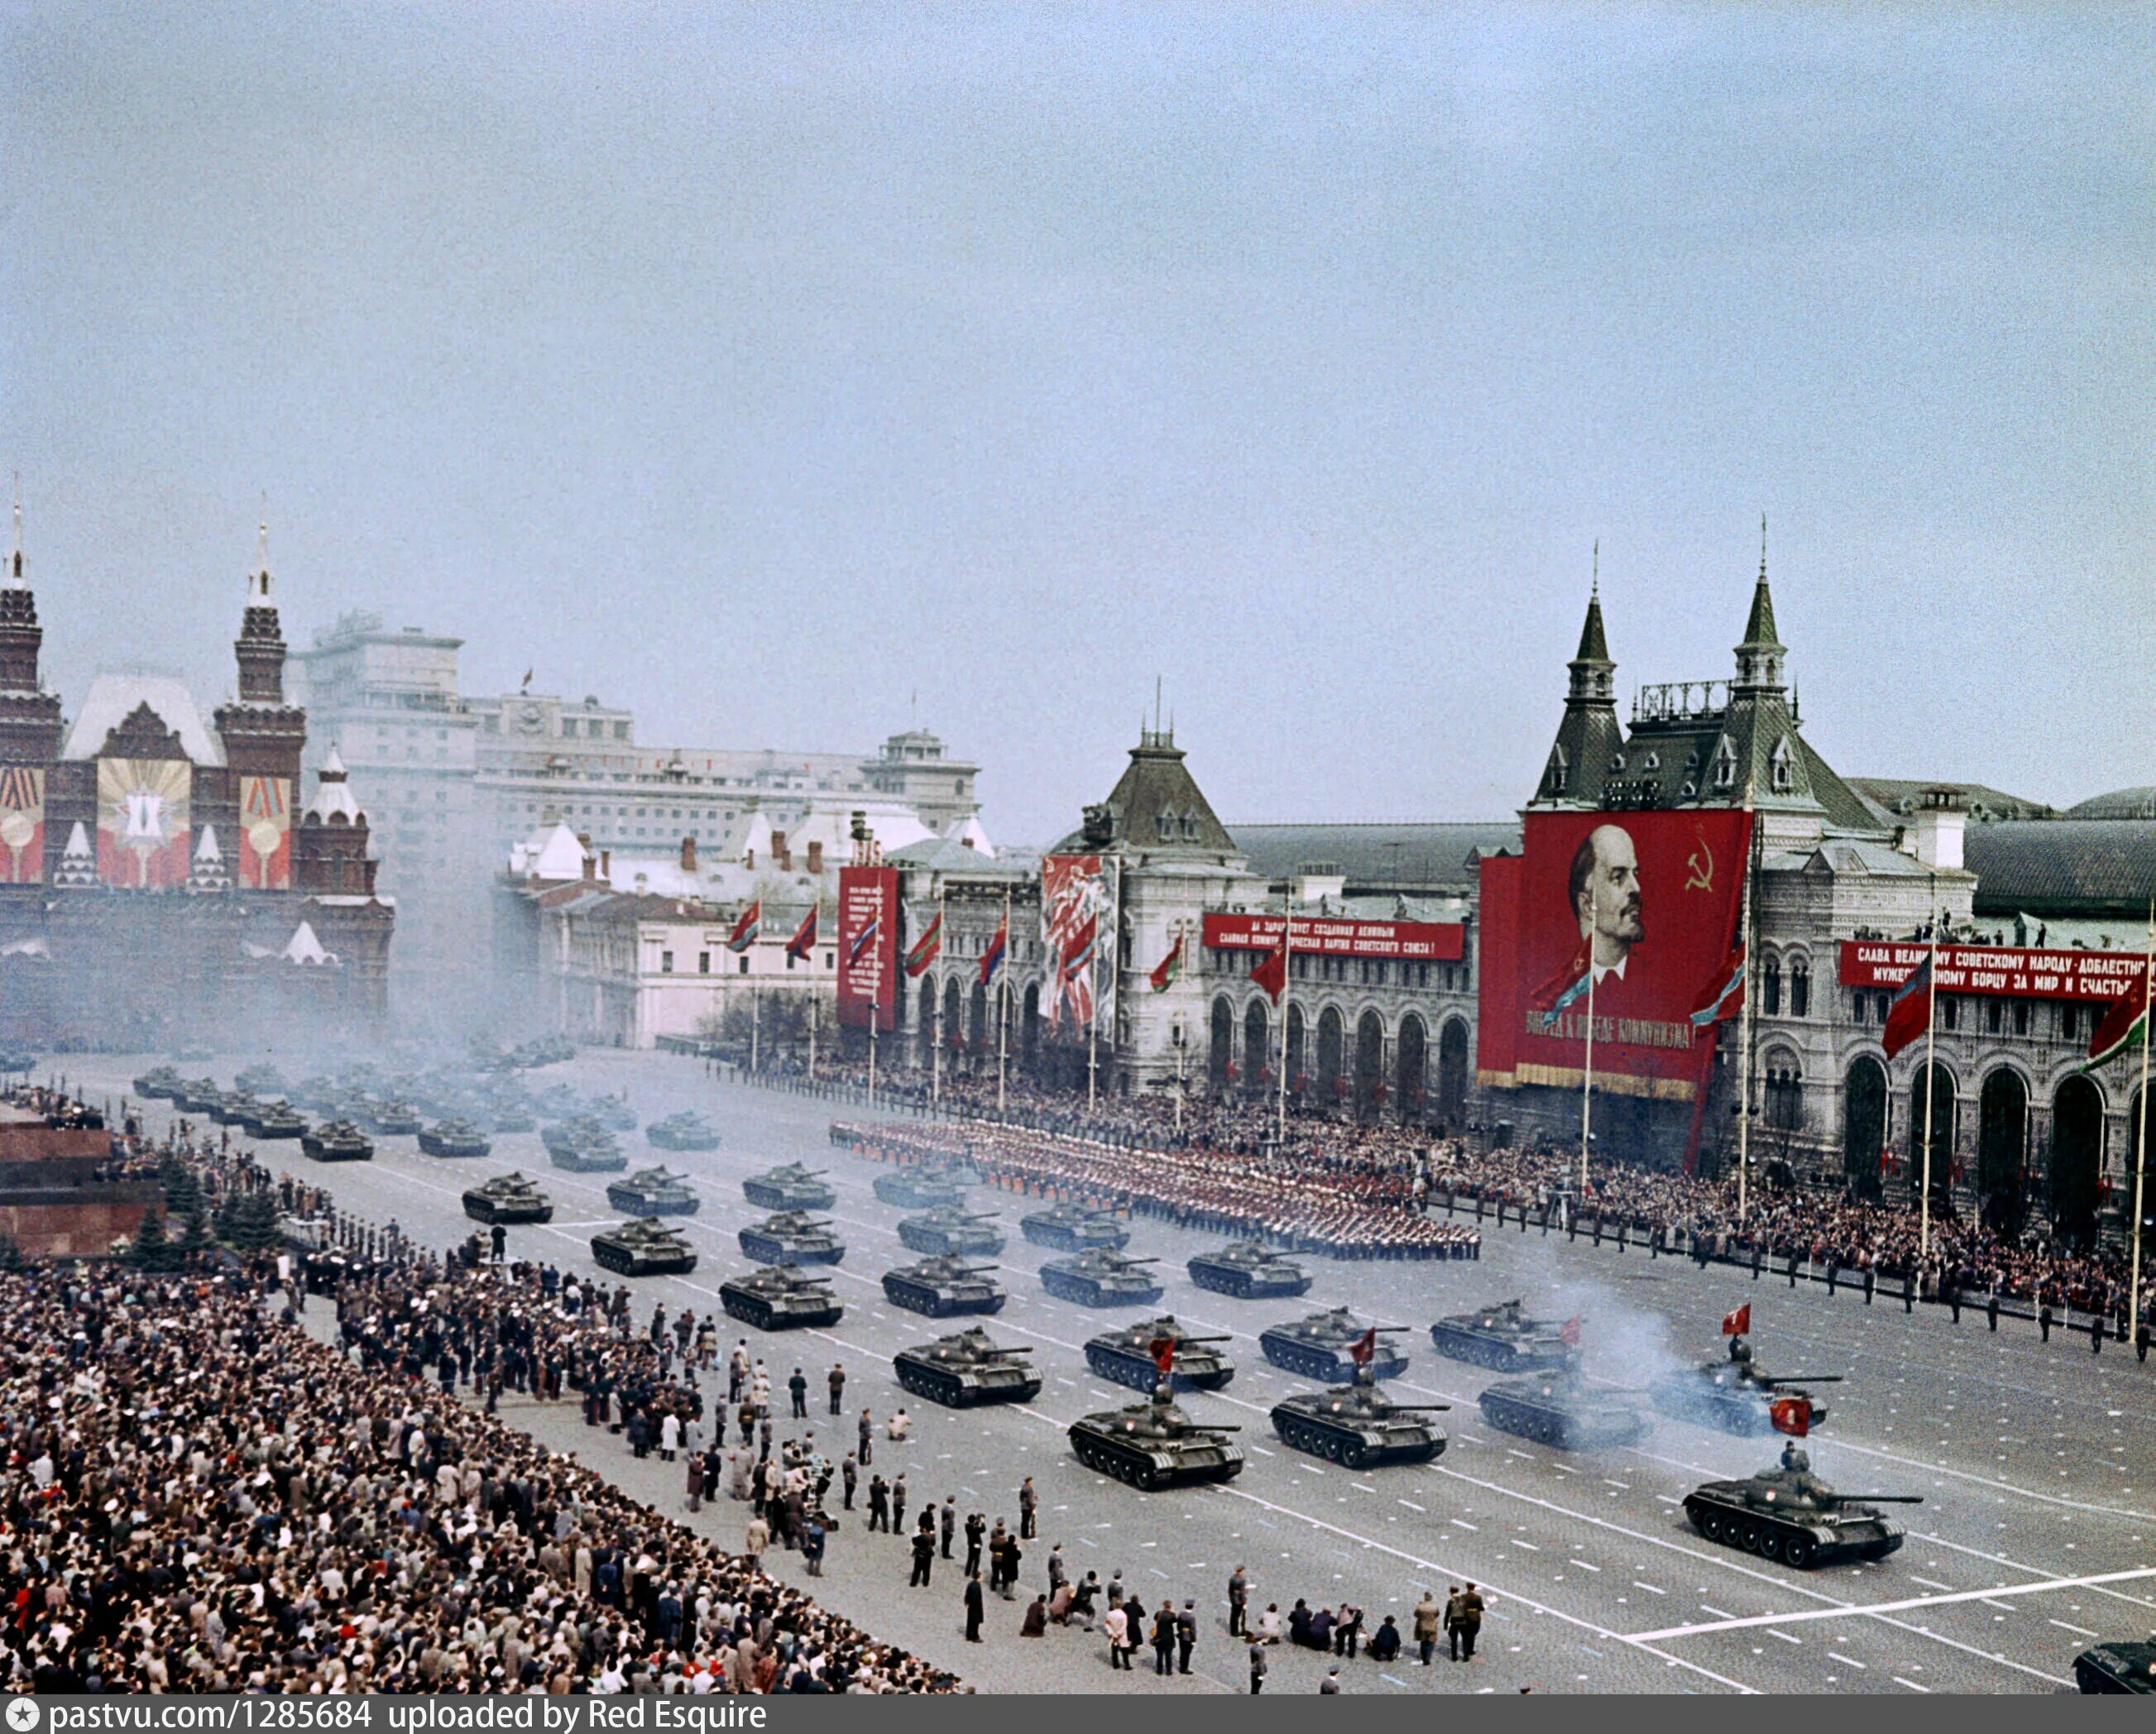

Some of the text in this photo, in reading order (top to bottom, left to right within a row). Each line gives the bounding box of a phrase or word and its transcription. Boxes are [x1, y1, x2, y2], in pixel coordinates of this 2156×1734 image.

[1857, 947, 1890, 963] СЛАВА
[1895, 949, 1950, 966] ВЕЛИКМУ
[1956, 951, 2024, 970] СОВЕТСКОМУ
[2029, 955, 2072, 973] НАРОДУ
[1972, 972, 2007, 989] БОРЦУ
[2013, 974, 2028, 989] ЗА
[2034, 975, 2058, 991] МИР
[2065, 977, 2073, 992] И
